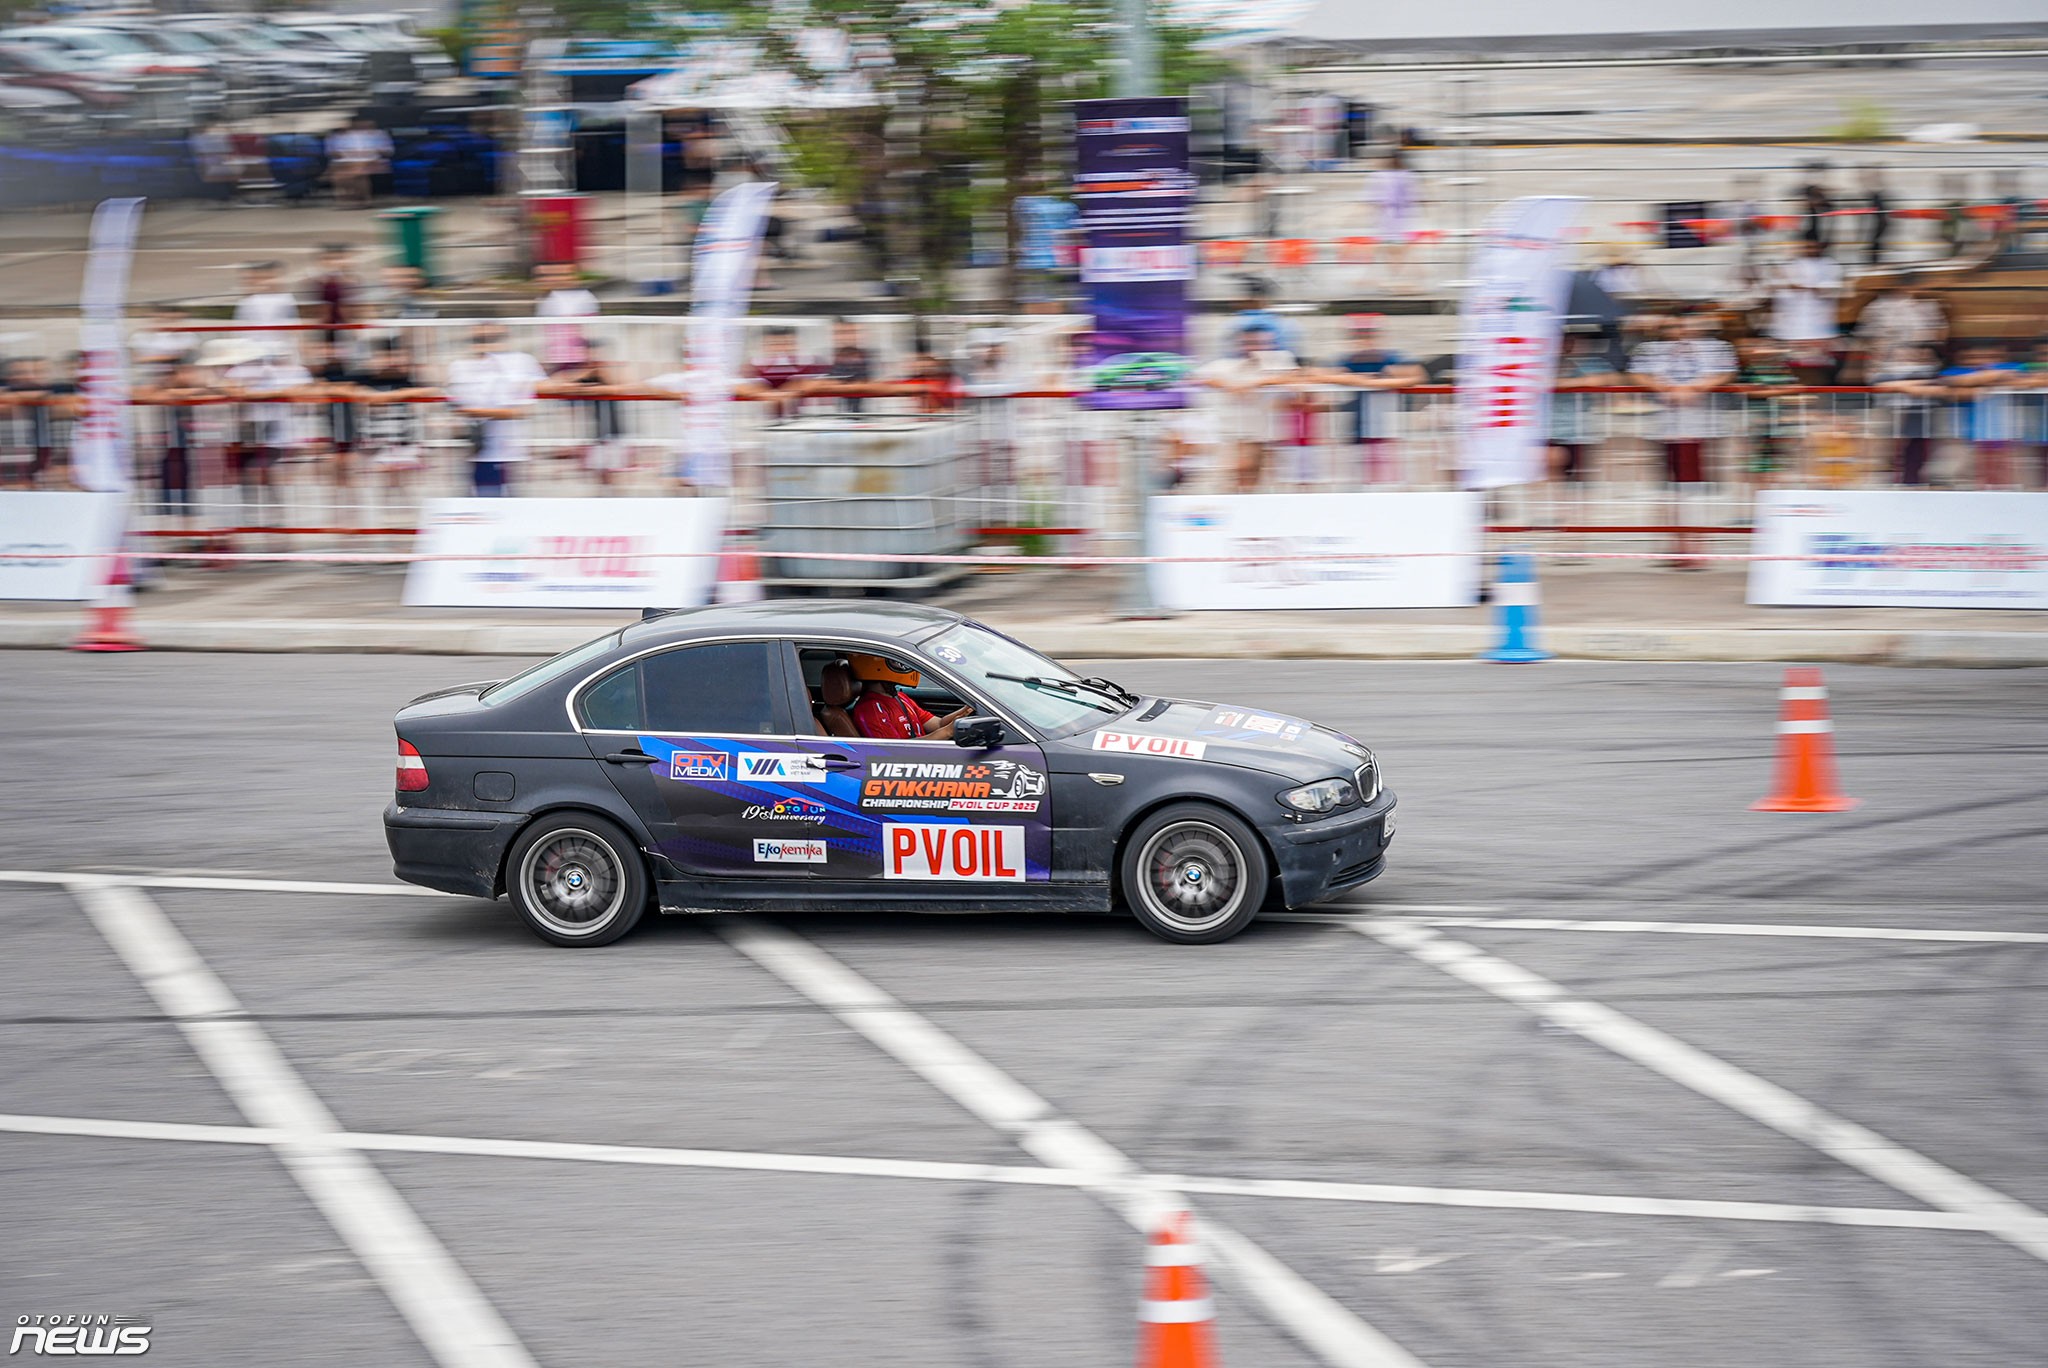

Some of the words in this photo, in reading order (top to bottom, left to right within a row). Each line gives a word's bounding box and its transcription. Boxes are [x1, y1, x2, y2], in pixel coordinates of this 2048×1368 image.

[1100, 733, 1195, 757] PVOIL
[675, 754, 725, 767] OTV
[674, 766, 725, 779] MEDIA
[871, 763, 963, 779] VIETNAM
[864, 780, 991, 798] GYMKHANA
[862, 799, 949, 809] CHAMPIONSHIP
[950, 801, 983, 810] PVOIL
[986, 802, 1010, 810] CUP
[1012, 802, 1036, 811] 2025
[760, 807, 826, 826] Anniversary
[757, 843, 823, 860] Ekokemika
[893, 828, 1016, 877] PVOIL
